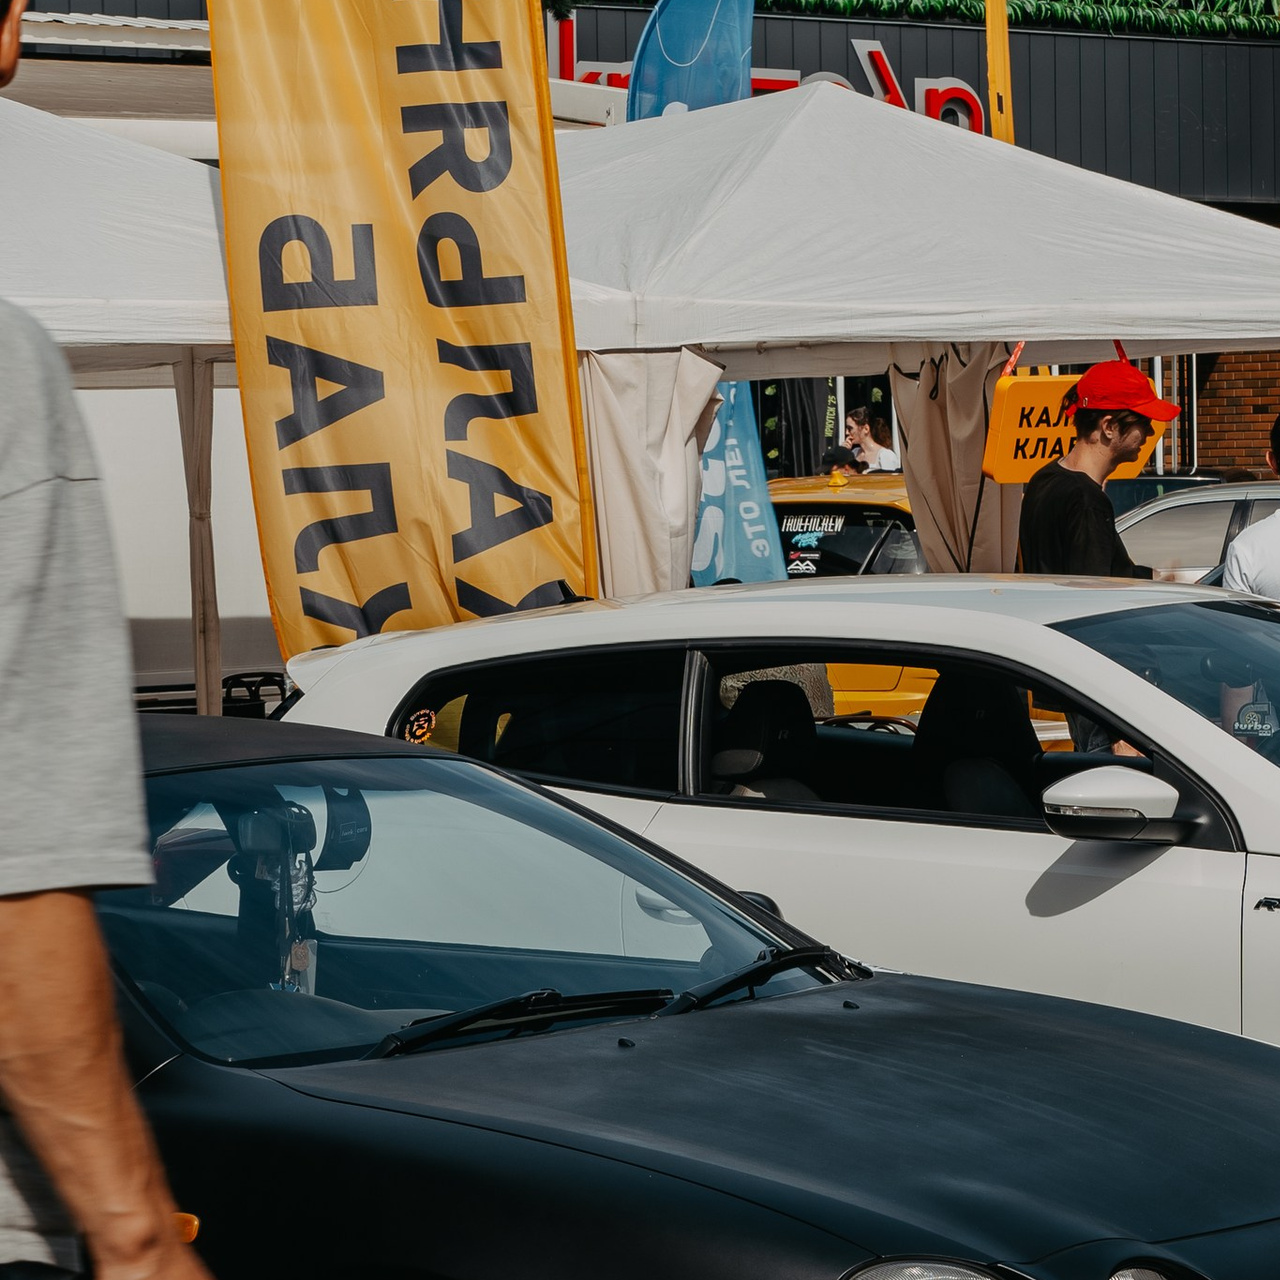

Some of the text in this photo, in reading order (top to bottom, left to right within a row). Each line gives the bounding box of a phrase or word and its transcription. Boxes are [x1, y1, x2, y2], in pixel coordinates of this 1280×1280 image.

[824, 406, 837, 438] ИРКУТСК
[1018, 406, 1076, 429] КАЛ
[739, 500, 770, 558] ЭТО
[1233, 721, 1271, 731] turbo
